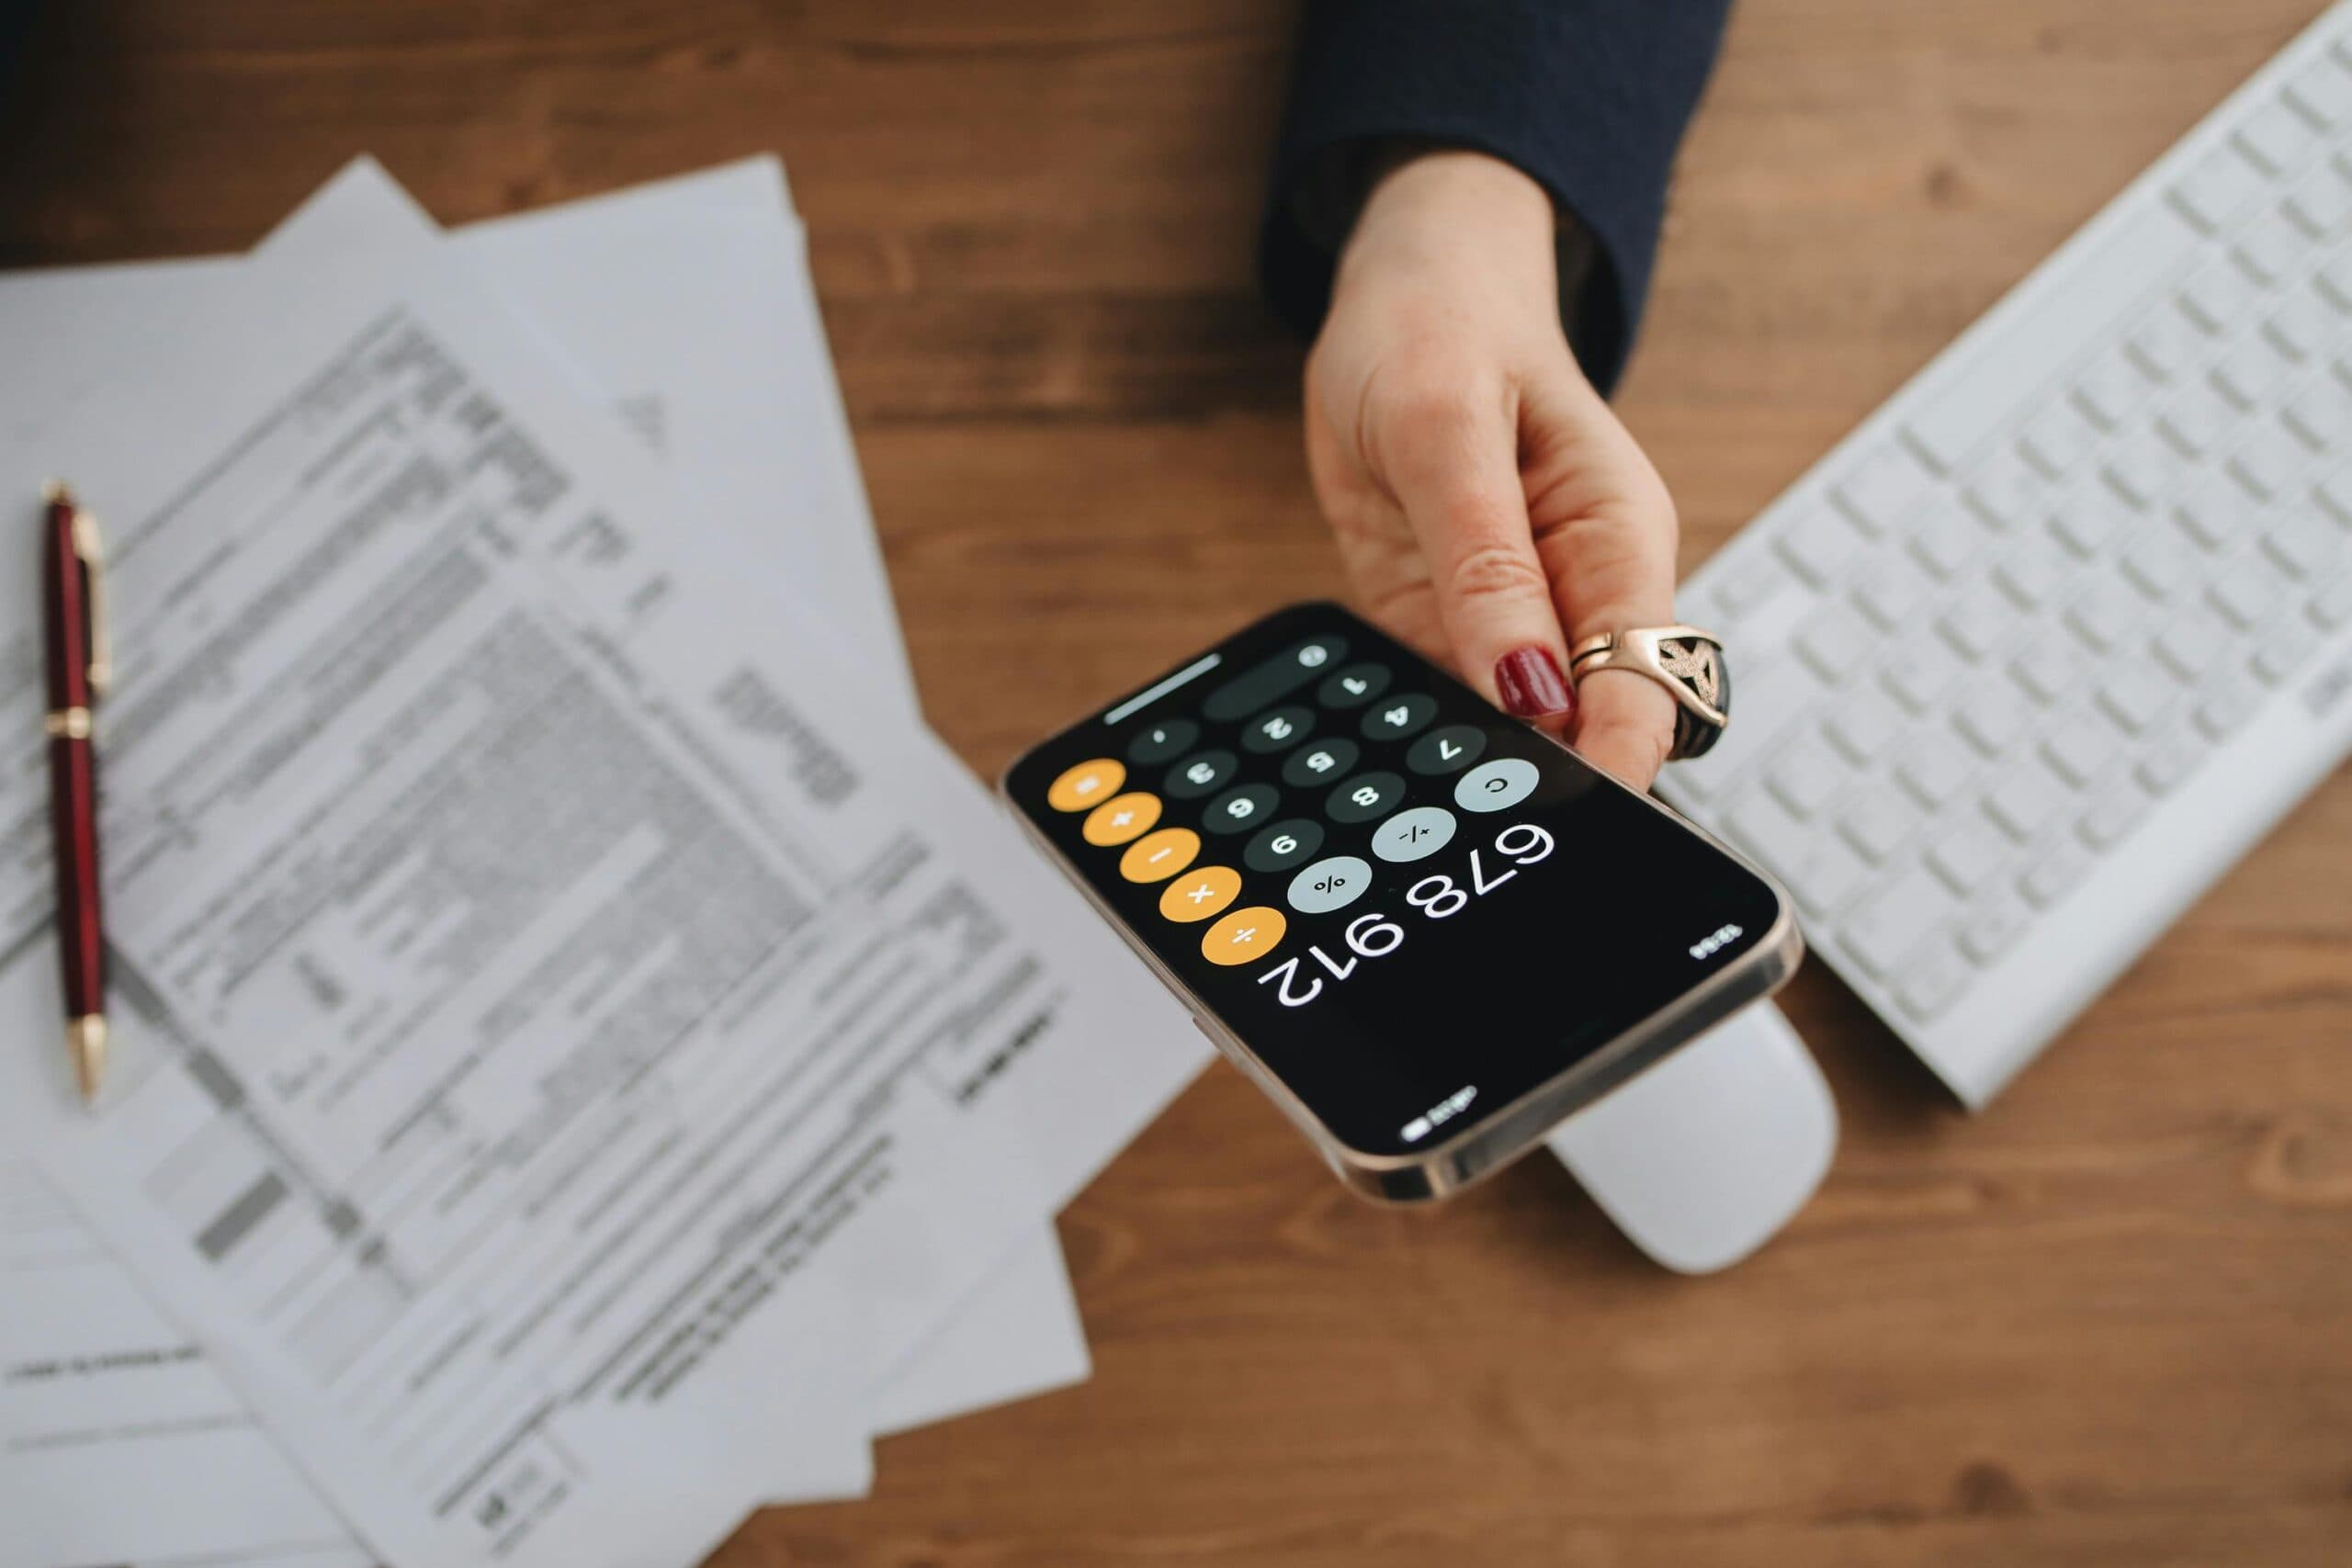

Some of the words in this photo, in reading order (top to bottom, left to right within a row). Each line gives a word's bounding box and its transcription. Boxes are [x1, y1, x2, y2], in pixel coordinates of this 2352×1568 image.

[1341, 677, 1367, 695] 1
[1384, 705, 1409, 728] 4
[1263, 717, 1291, 739] 2
[1438, 739, 1463, 761] 7
[1187, 762, 1215, 784] 3
[1306, 751, 1335, 773] 5
[1352, 786, 1380, 807] 8
[1485, 778, 1509, 794] C
[1227, 798, 1254, 818] 6
[1271, 835, 1297, 854] 9
[1406, 823, 1555, 919] 678
[1314, 875, 1346, 894] %
[1257, 913, 1404, 1008] 912
